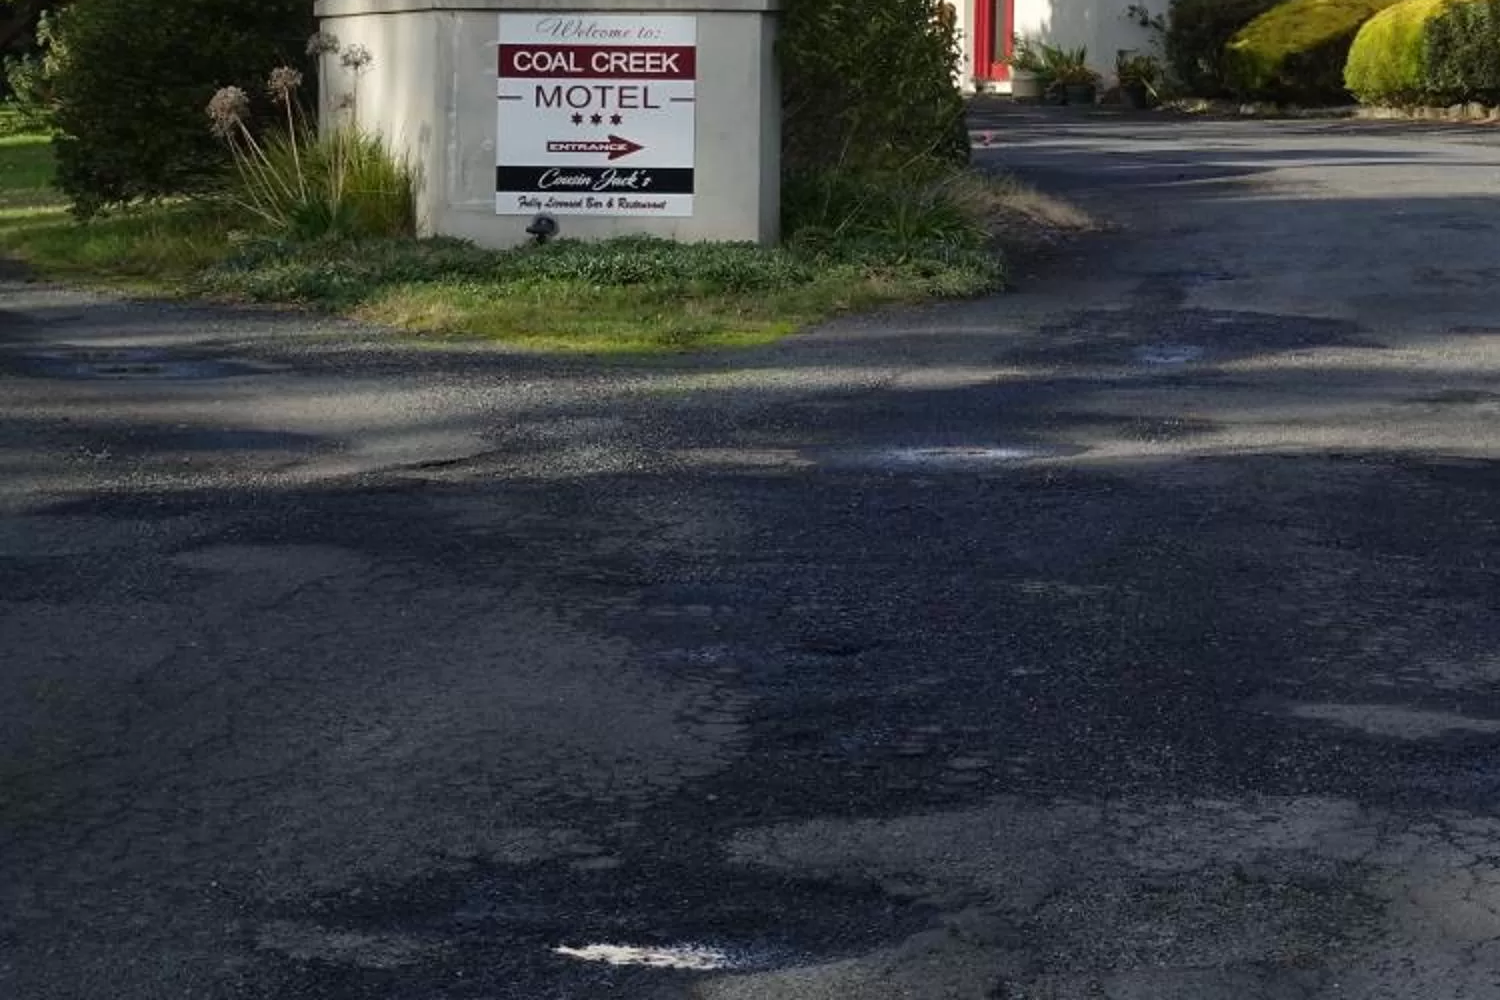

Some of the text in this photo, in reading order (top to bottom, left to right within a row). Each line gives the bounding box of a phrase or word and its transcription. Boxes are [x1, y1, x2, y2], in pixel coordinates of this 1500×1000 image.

[535, 17, 662, 40] Welcome to:
[512, 51, 681, 74] COAL CREEK
[534, 84, 661, 110] MOTEL
[549, 142, 628, 151] ENTRANCE
[537, 167, 653, 191] Cousin Jack's
